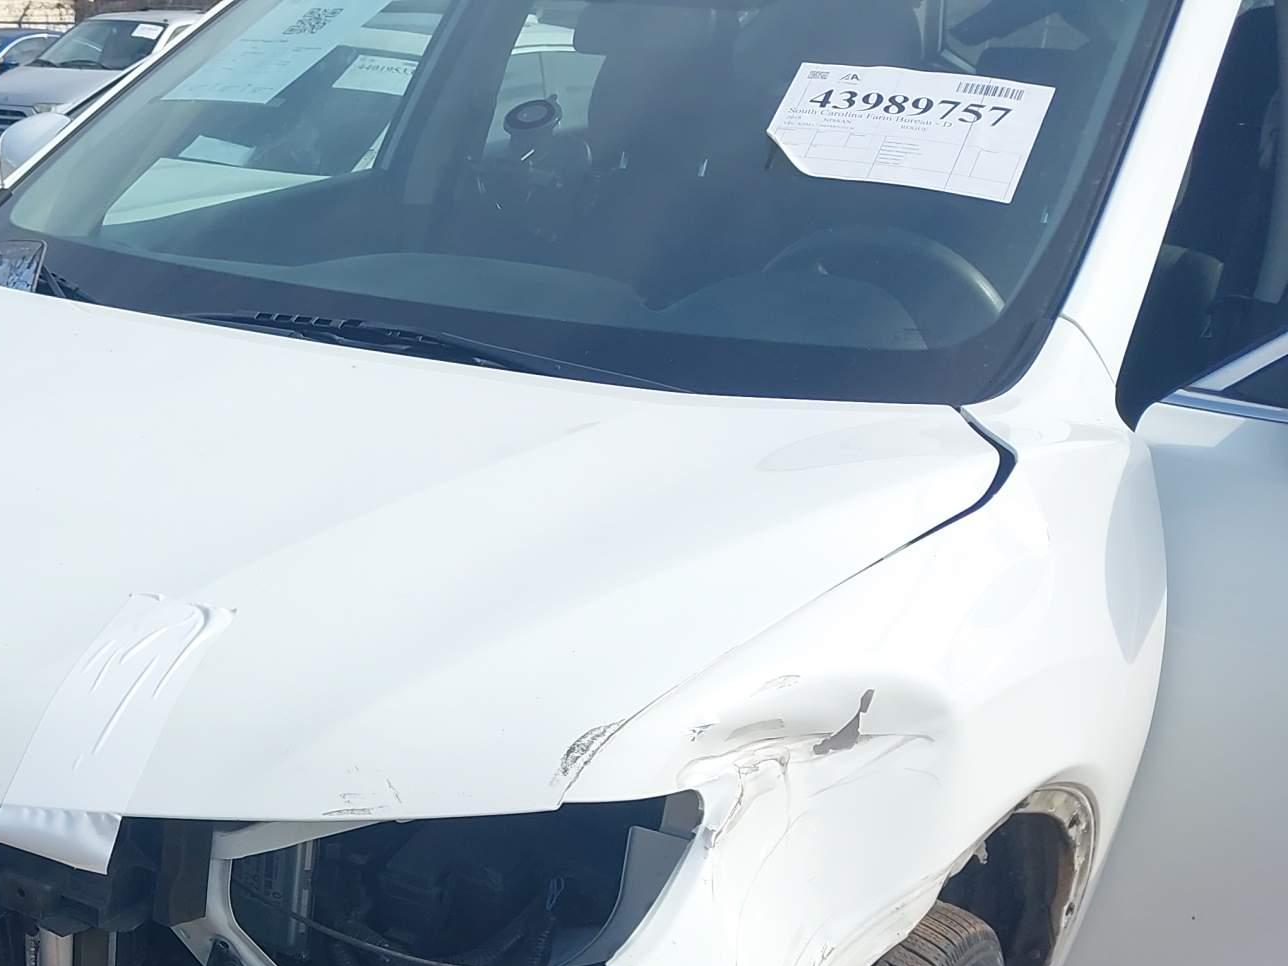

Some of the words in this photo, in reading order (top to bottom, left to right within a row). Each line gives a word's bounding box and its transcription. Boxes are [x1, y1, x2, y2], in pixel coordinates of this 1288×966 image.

[788, 107, 817, 115] South
[820, 109, 863, 119] Carolina
[809, 89, 1012, 127] 43989757
